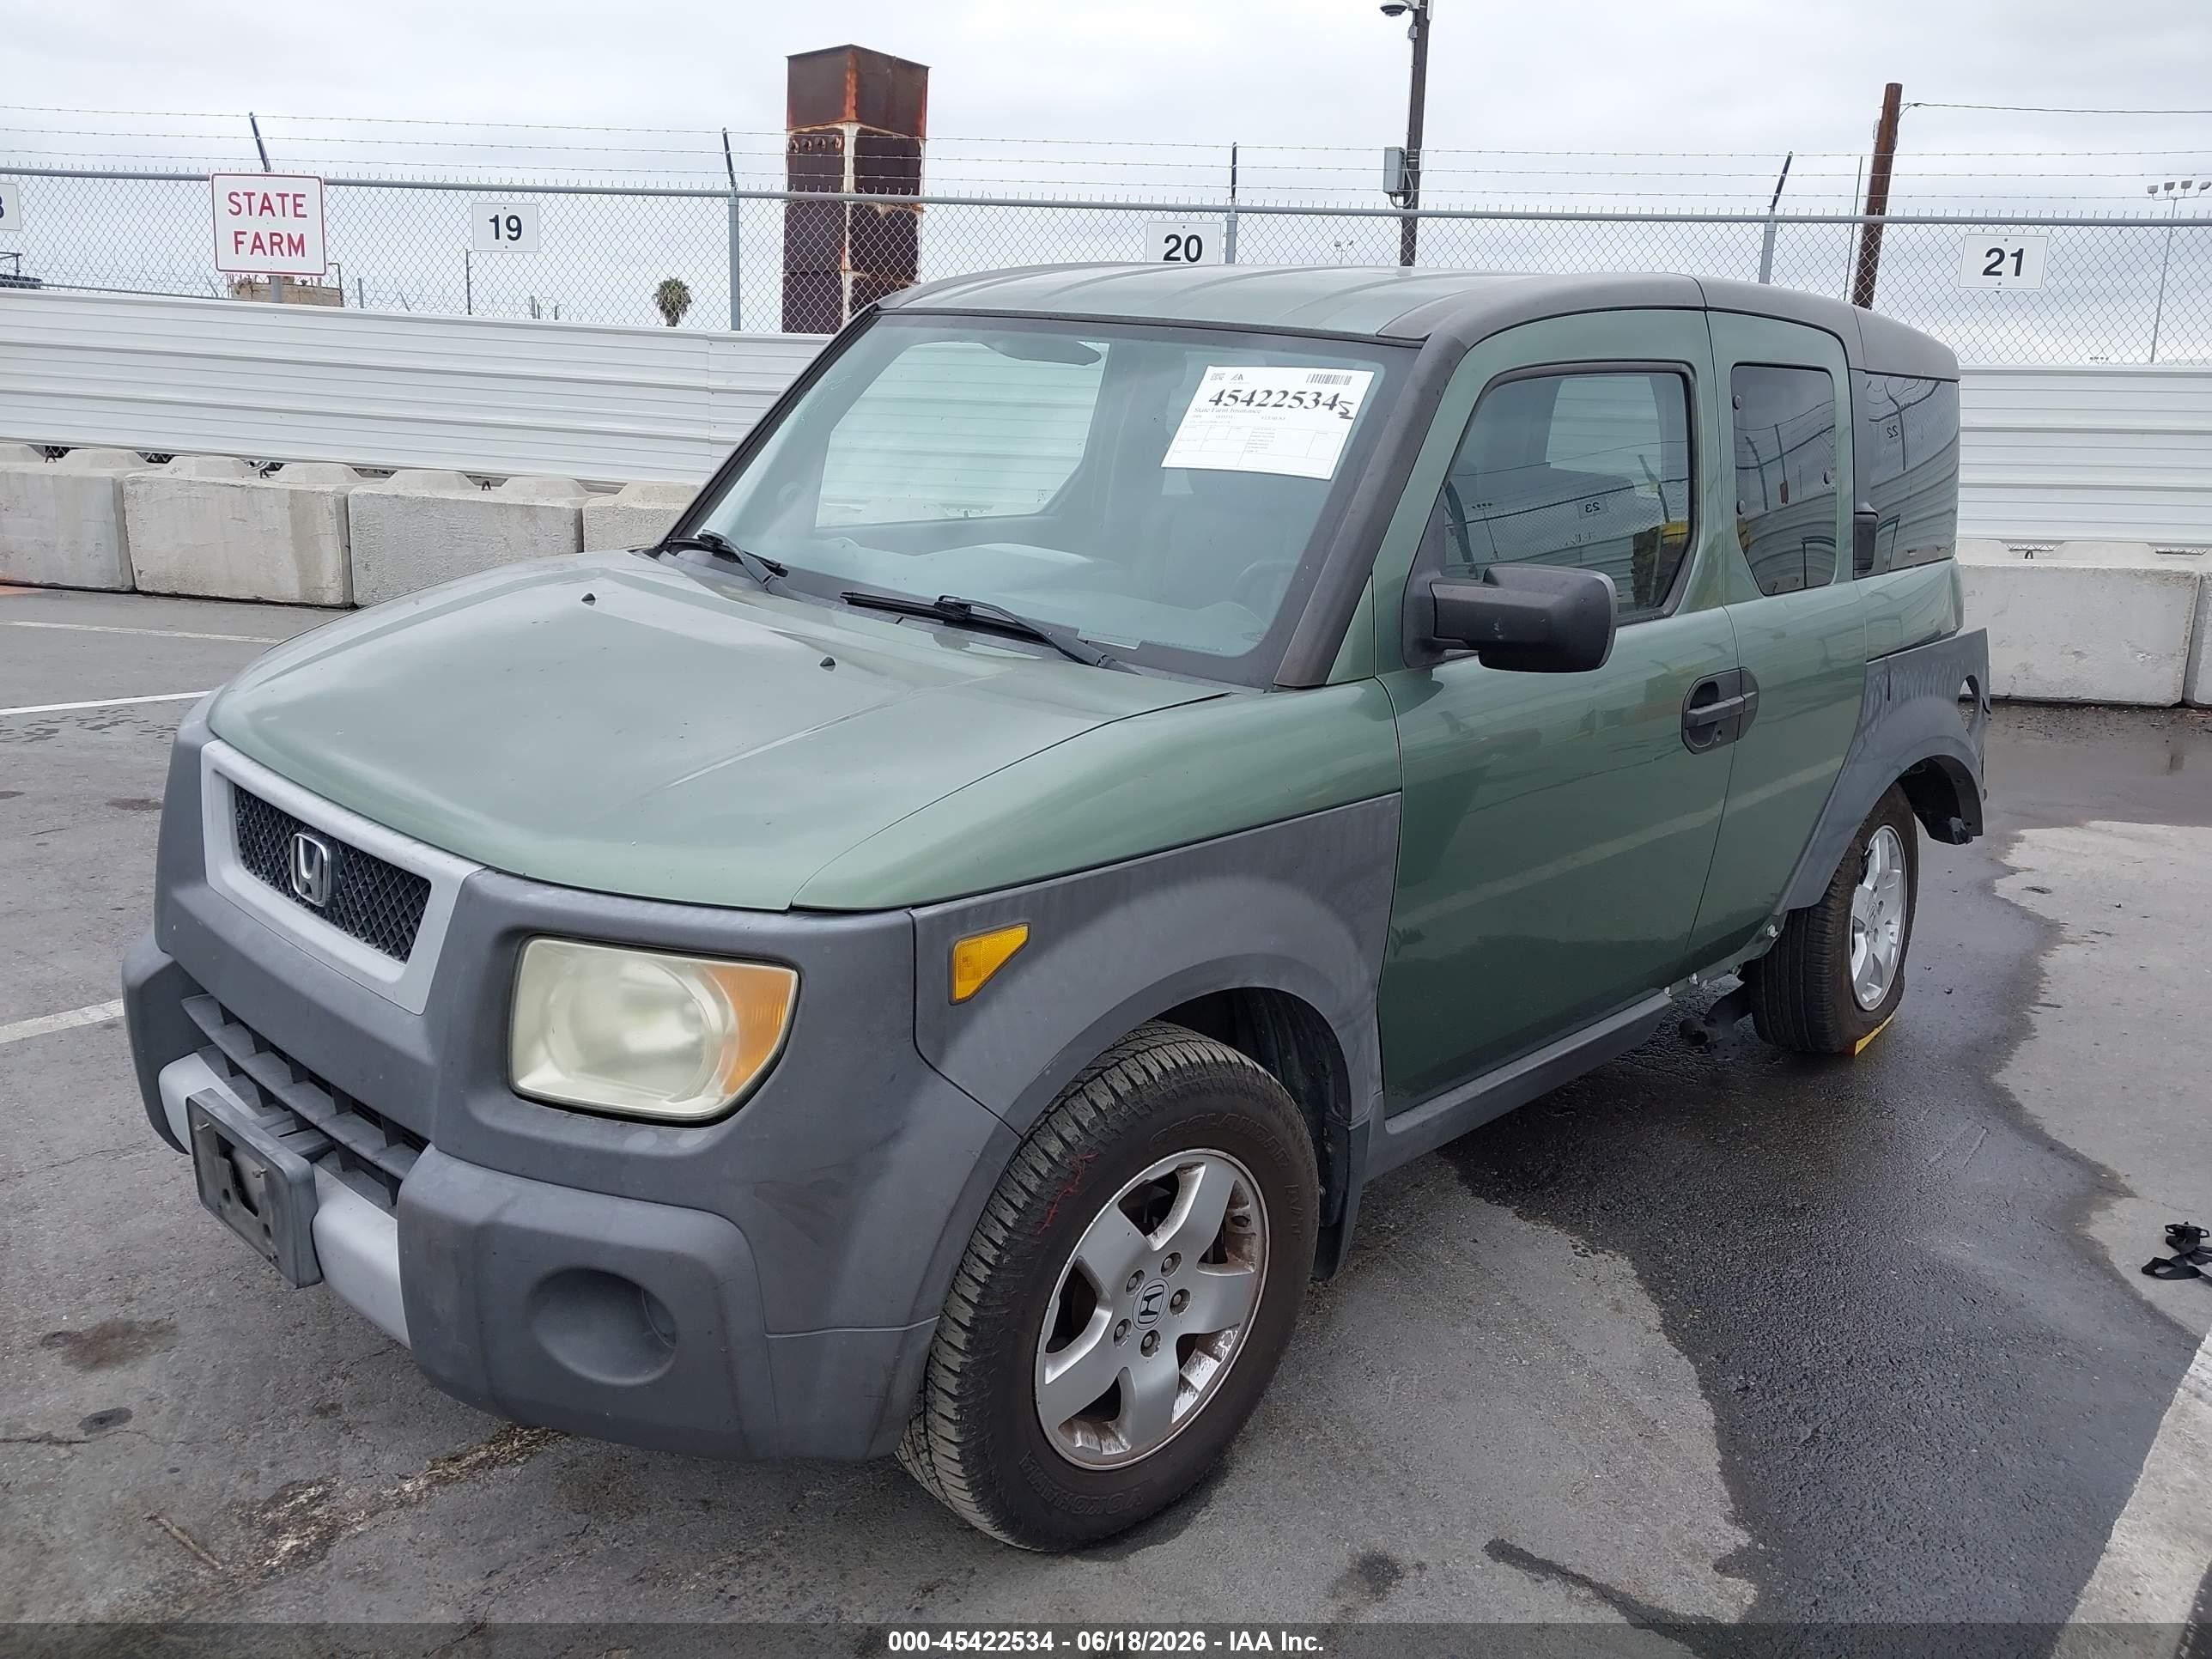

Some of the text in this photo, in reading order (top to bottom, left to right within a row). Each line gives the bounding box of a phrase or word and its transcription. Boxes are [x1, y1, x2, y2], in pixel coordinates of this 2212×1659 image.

[228, 191, 307, 219] STATE
[488, 214, 523, 241] 19
[234, 230, 306, 258] FARM
[1163, 234, 1203, 263] 20
[1981, 246, 2025, 277] 21
[1208, 388, 1340, 411] 45422534
